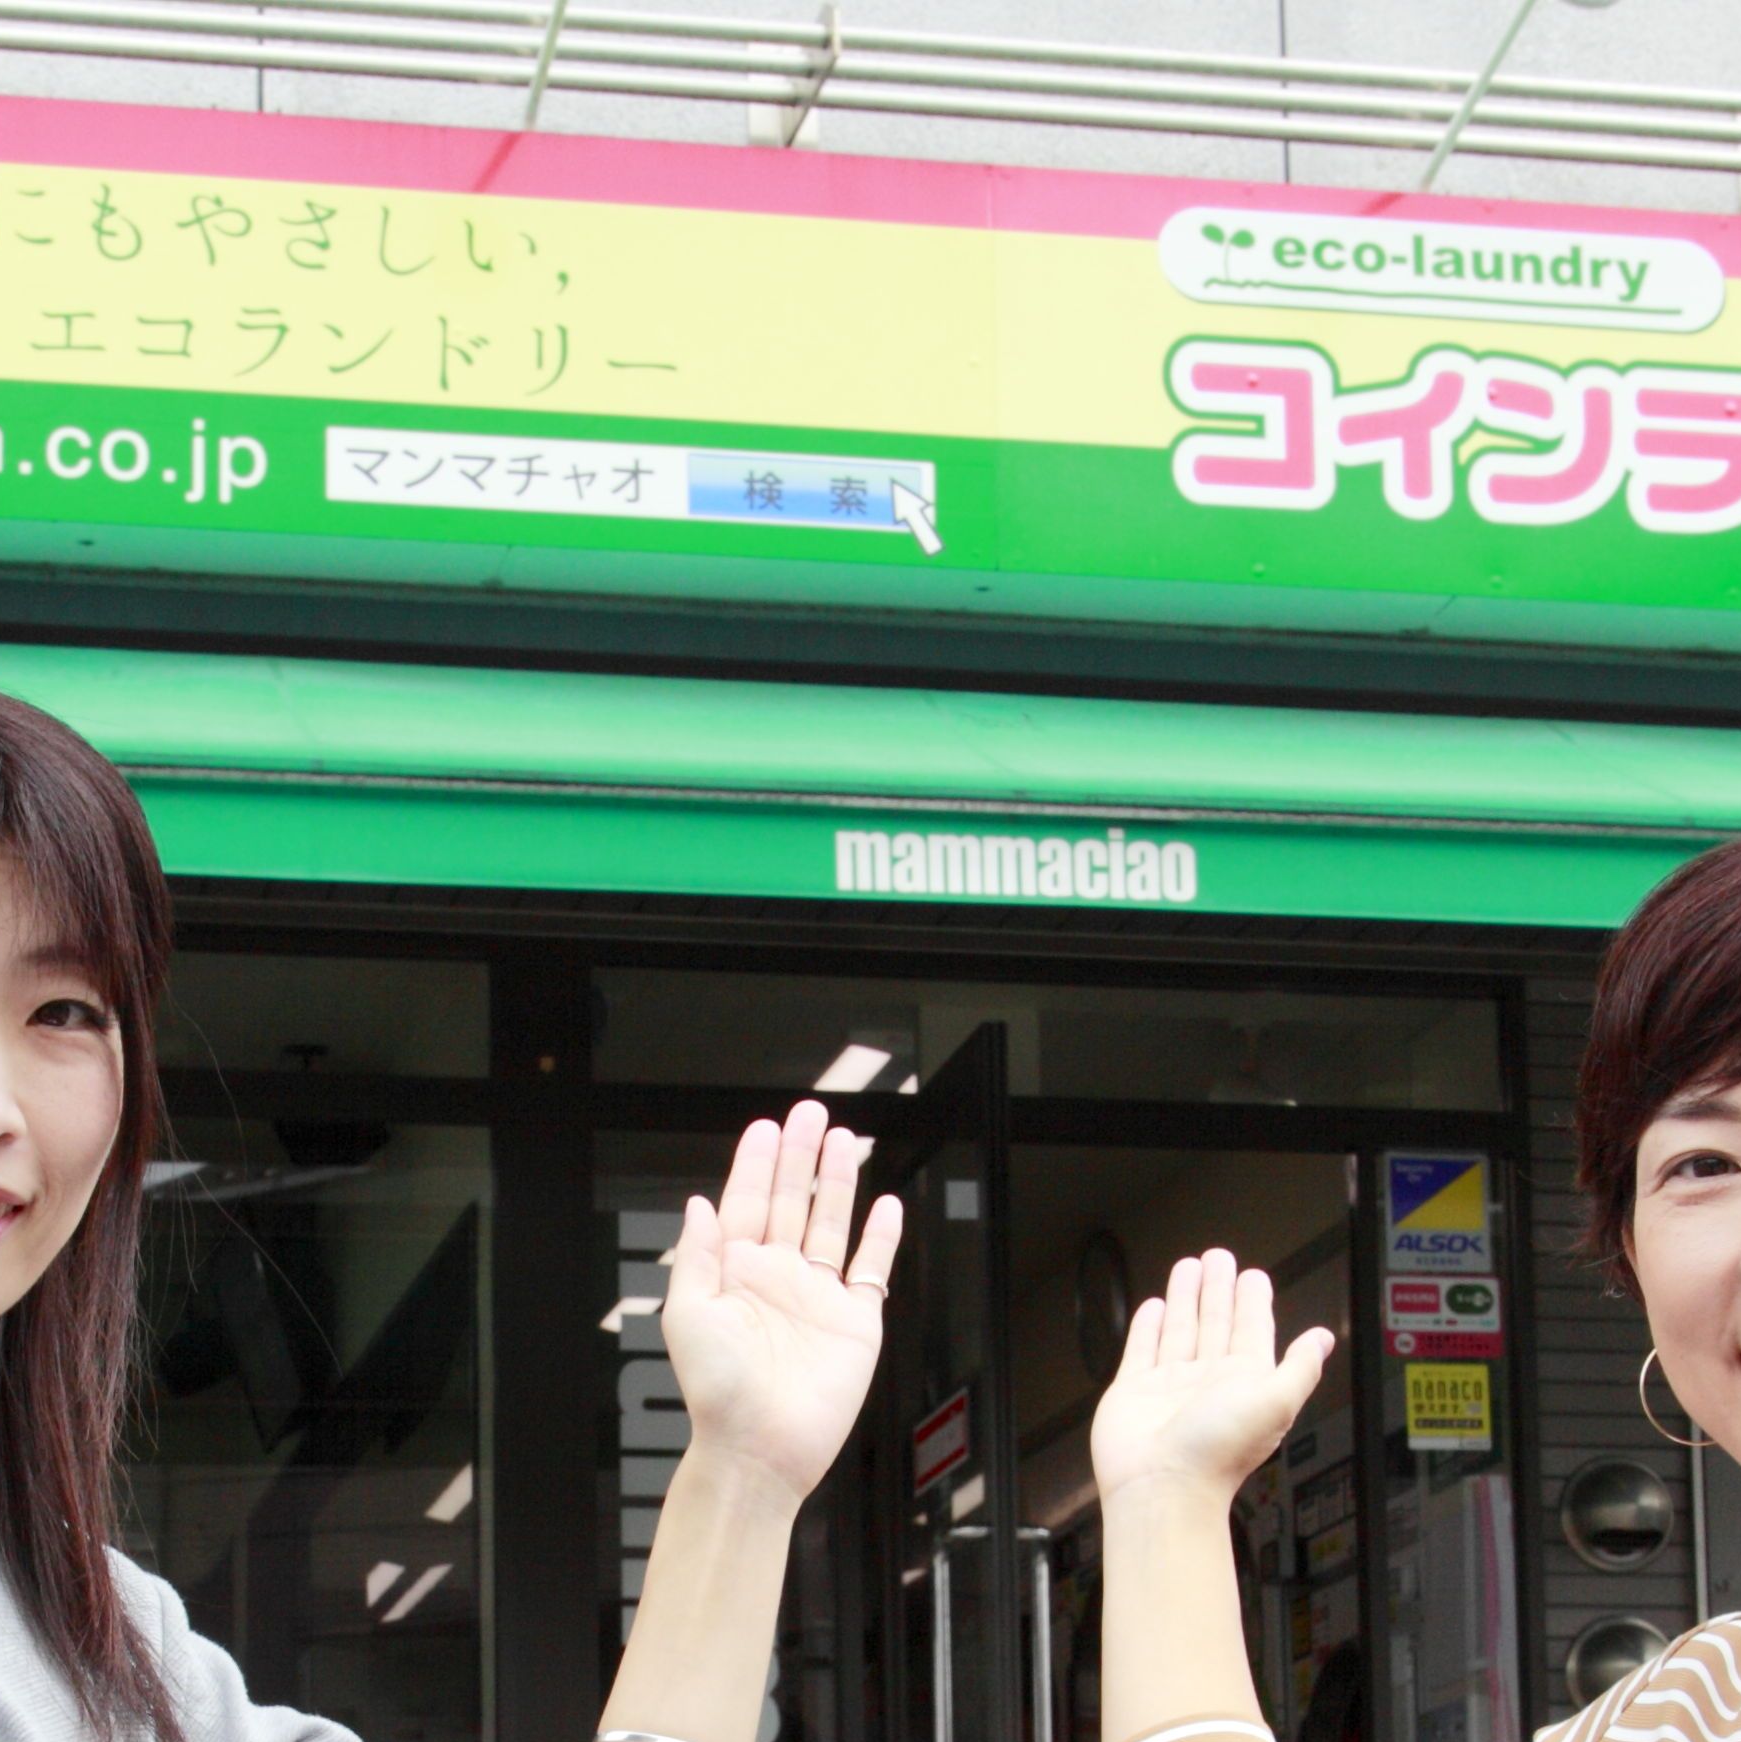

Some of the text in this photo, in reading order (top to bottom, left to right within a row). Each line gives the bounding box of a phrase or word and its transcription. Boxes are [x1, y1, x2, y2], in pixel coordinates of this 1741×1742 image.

[1271, 235, 1649, 302] eco-laundry
[29, 305, 679, 395] エコランドリー
[345, 445, 655, 504] マンマチャオ
[835, 828, 1197, 903] mammaciao
[1394, 1232, 1485, 1255] ALSOK
[1412, 1380, 1483, 1401] nanaco
